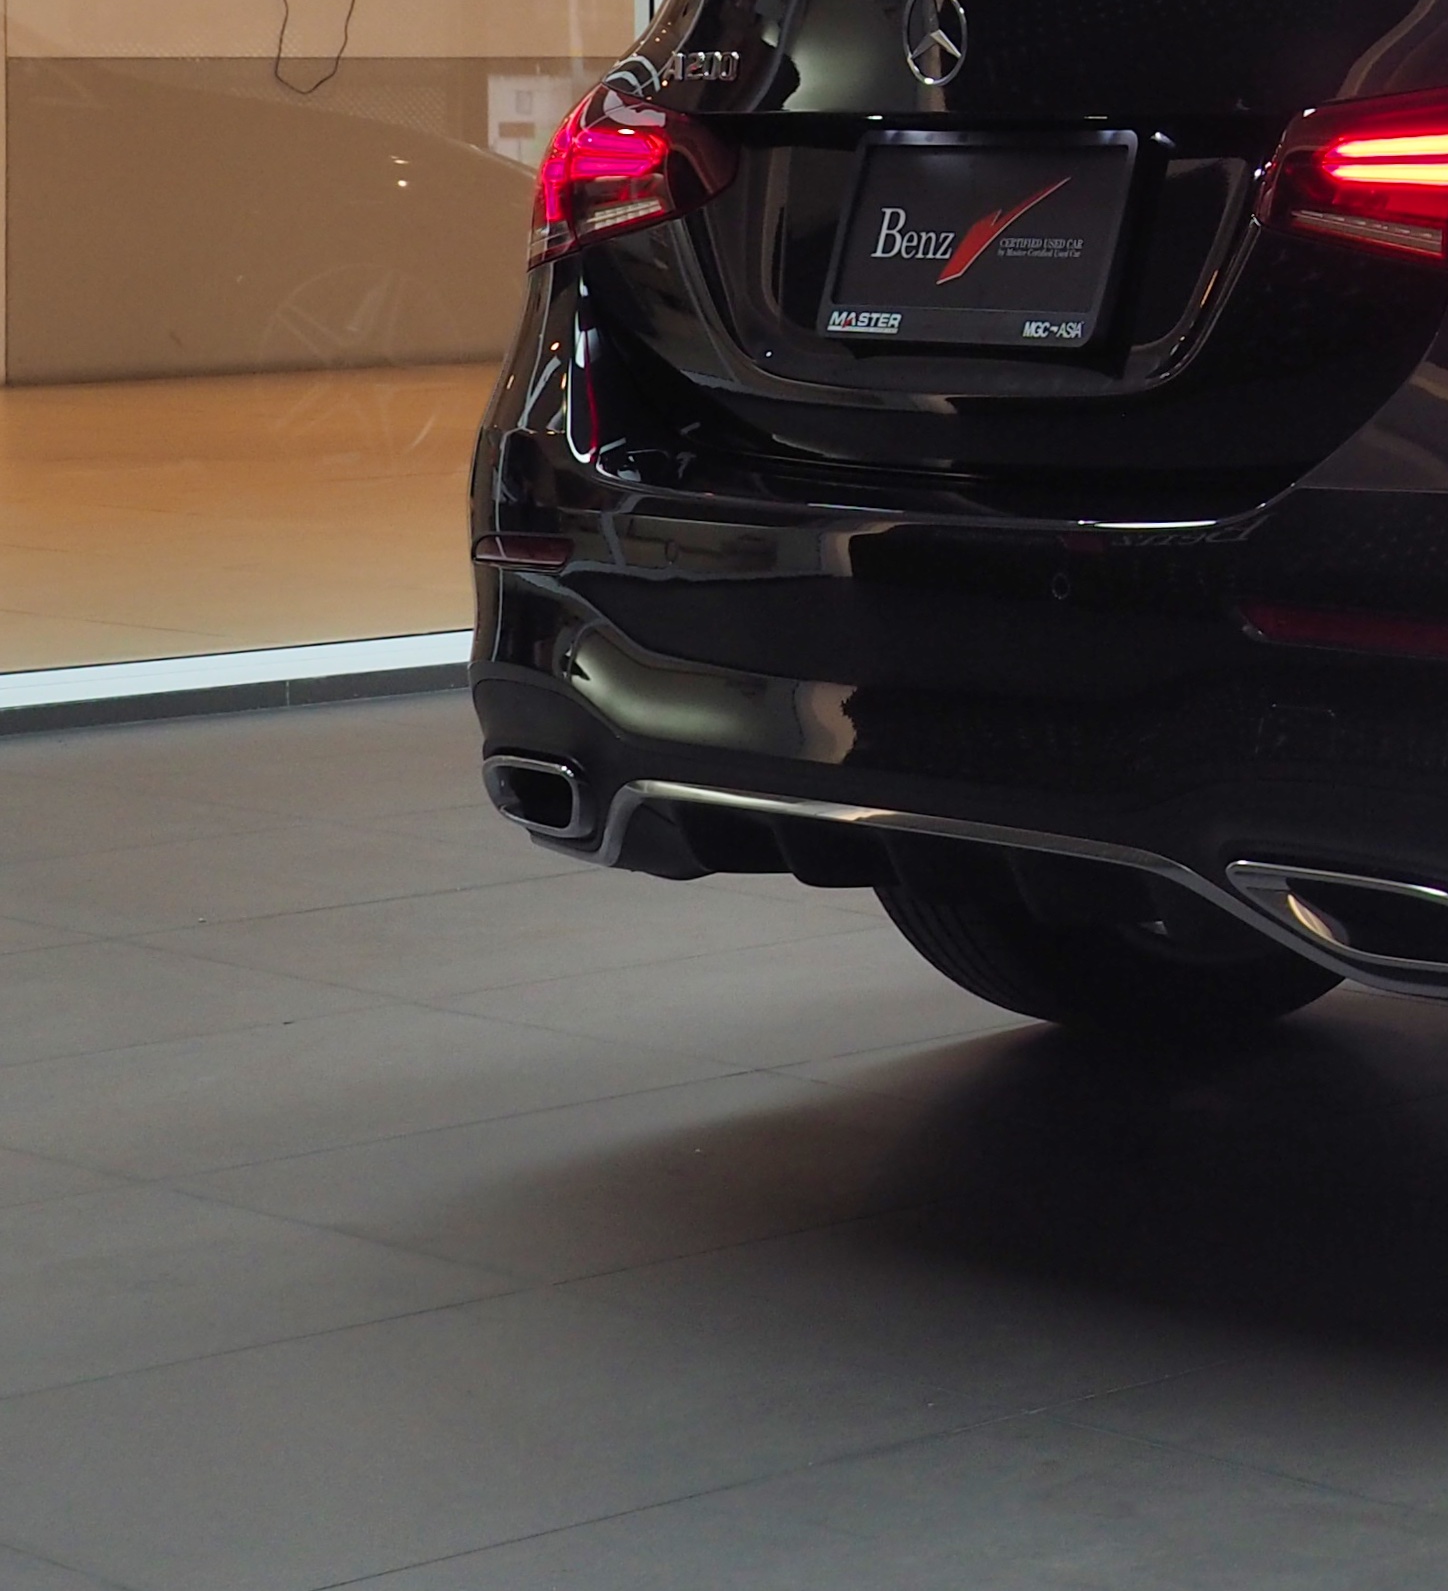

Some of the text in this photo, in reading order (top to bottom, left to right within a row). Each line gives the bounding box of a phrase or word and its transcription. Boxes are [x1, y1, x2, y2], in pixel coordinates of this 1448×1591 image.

[870, 207, 954, 259] Benz
[1000, 237, 1084, 249] CERTIFIED USED CAR
[828, 310, 902, 329] MASTER
